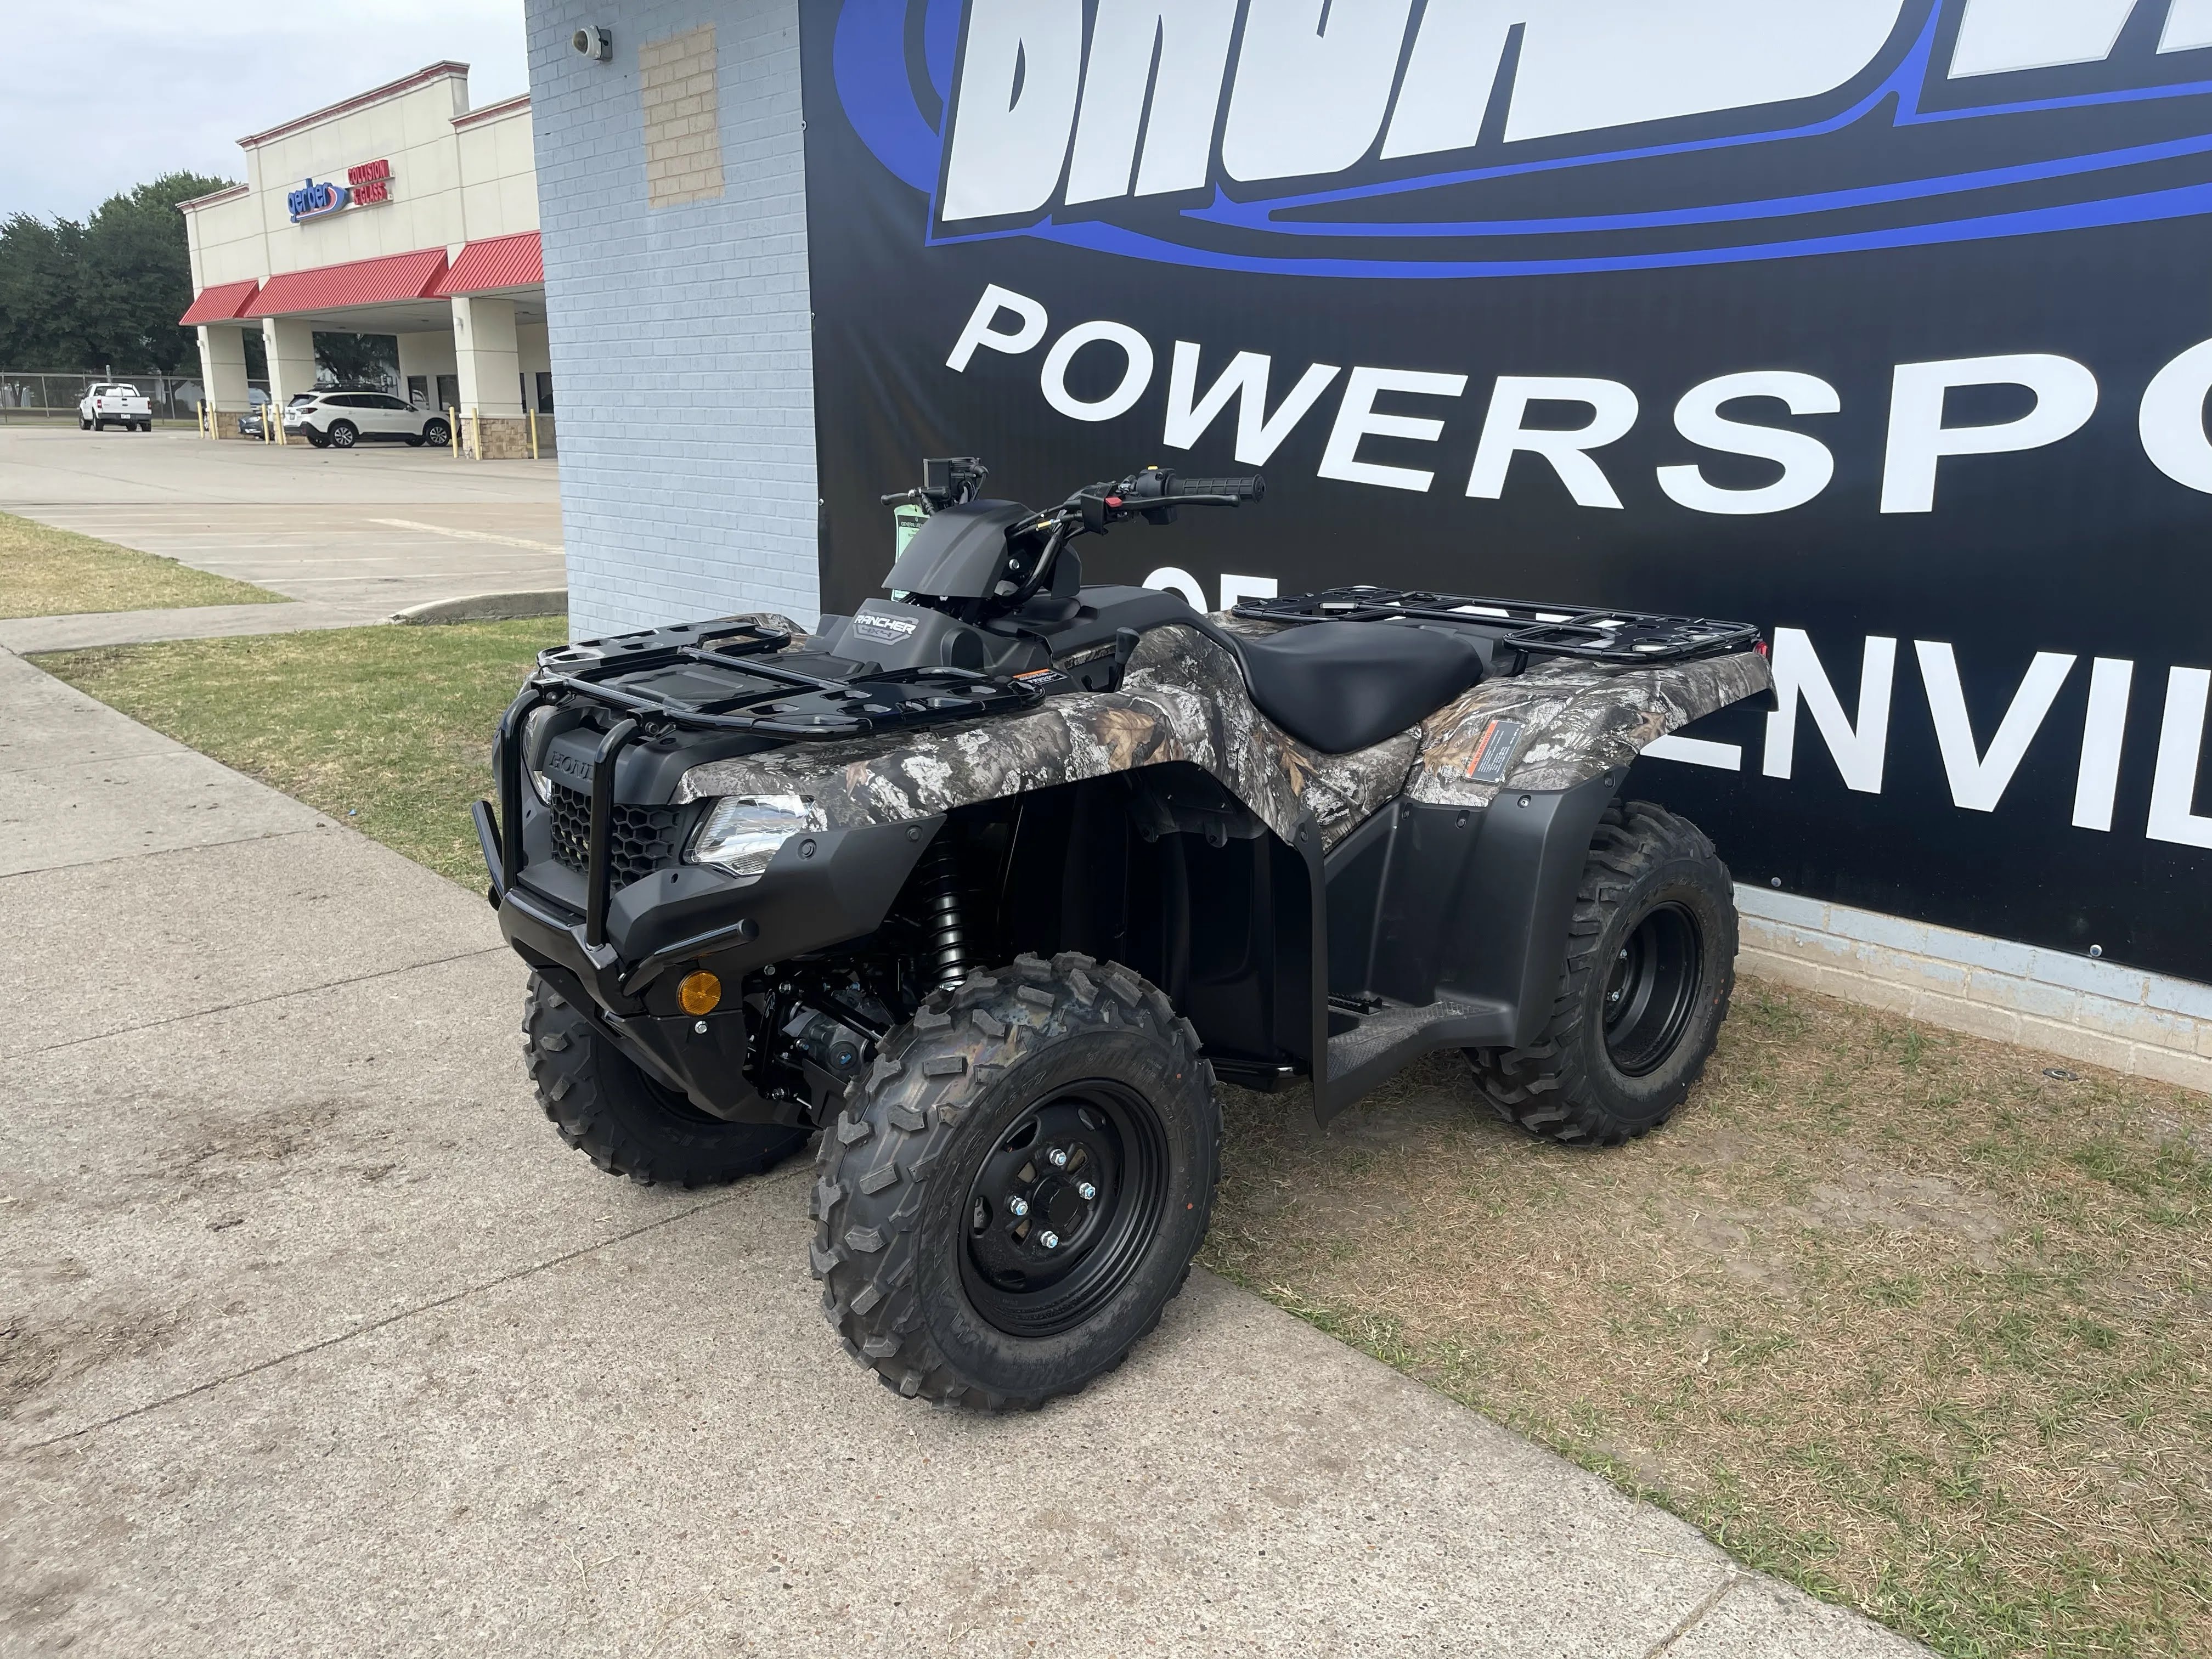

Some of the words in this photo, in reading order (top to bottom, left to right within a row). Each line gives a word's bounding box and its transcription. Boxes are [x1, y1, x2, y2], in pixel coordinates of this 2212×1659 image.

[348, 160, 390, 185] COLLISION
[288, 178, 332, 223] gerber
[360, 182, 388, 204] GLASS
[854, 614, 917, 635] RANCHER
[1475, 732, 1492, 760] WARNING
